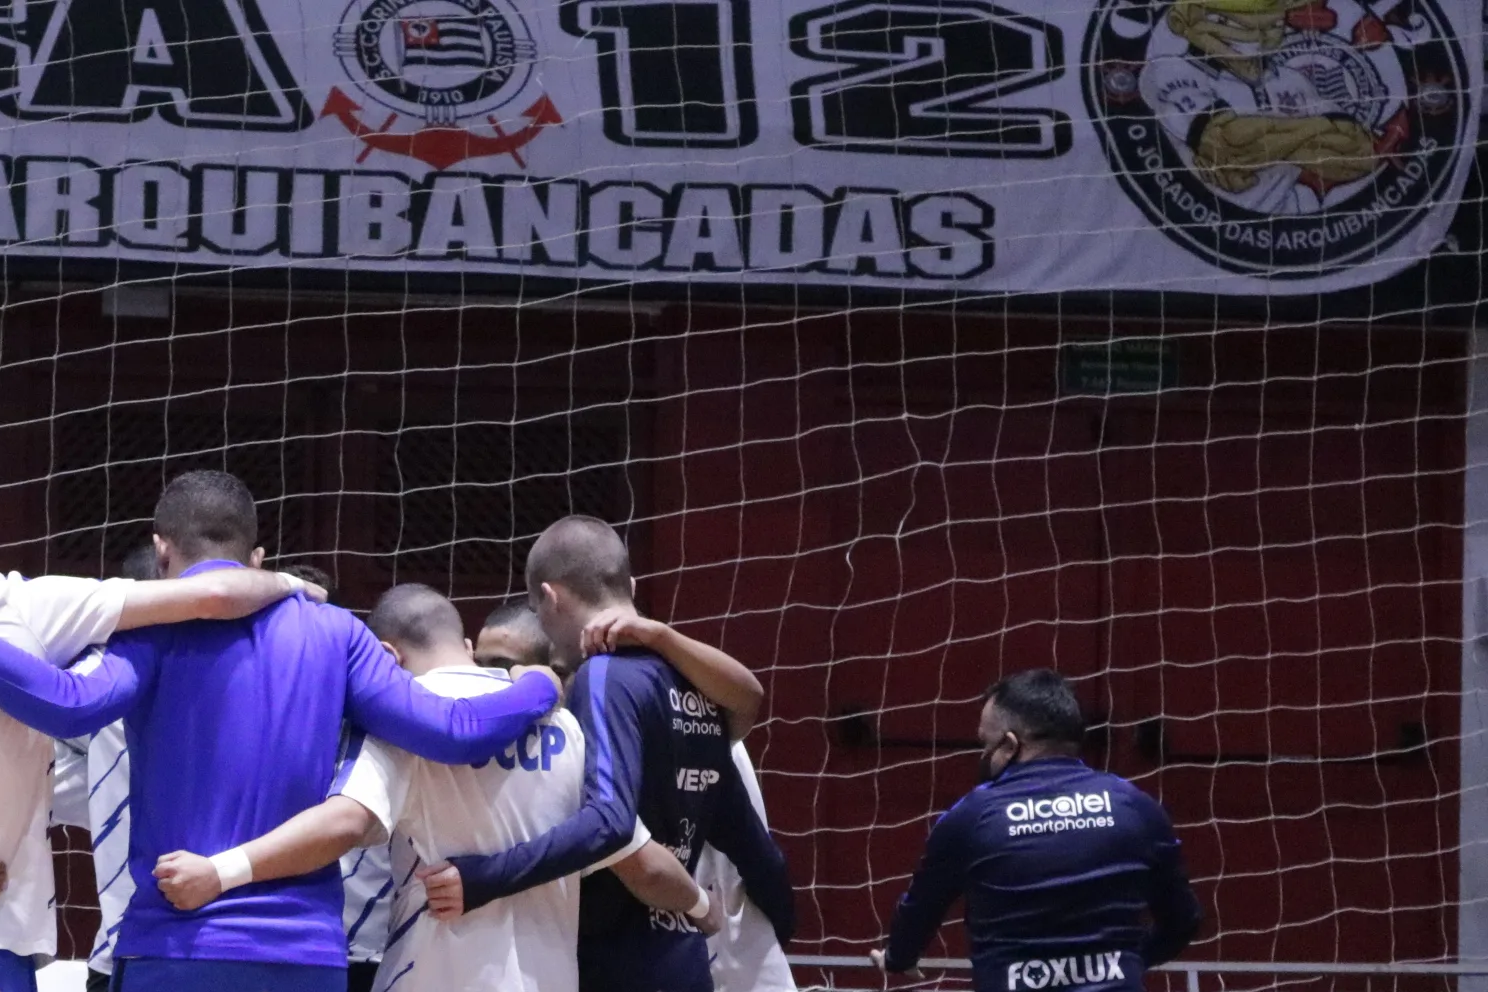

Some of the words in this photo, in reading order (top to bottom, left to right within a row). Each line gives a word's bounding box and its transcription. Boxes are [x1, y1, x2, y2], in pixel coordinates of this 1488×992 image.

[560, 0, 1073, 158] 12
[418, 89, 464, 104] 1910
[1127, 123, 1148, 140] O
[1136, 145, 1222, 233] JOGADOR
[1276, 136, 1439, 250] ARQUIBANCADAS
[1224, 222, 1272, 249] DAS
[1006, 790, 1112, 822] alcatel
[1008, 814, 1116, 837] smartphones
